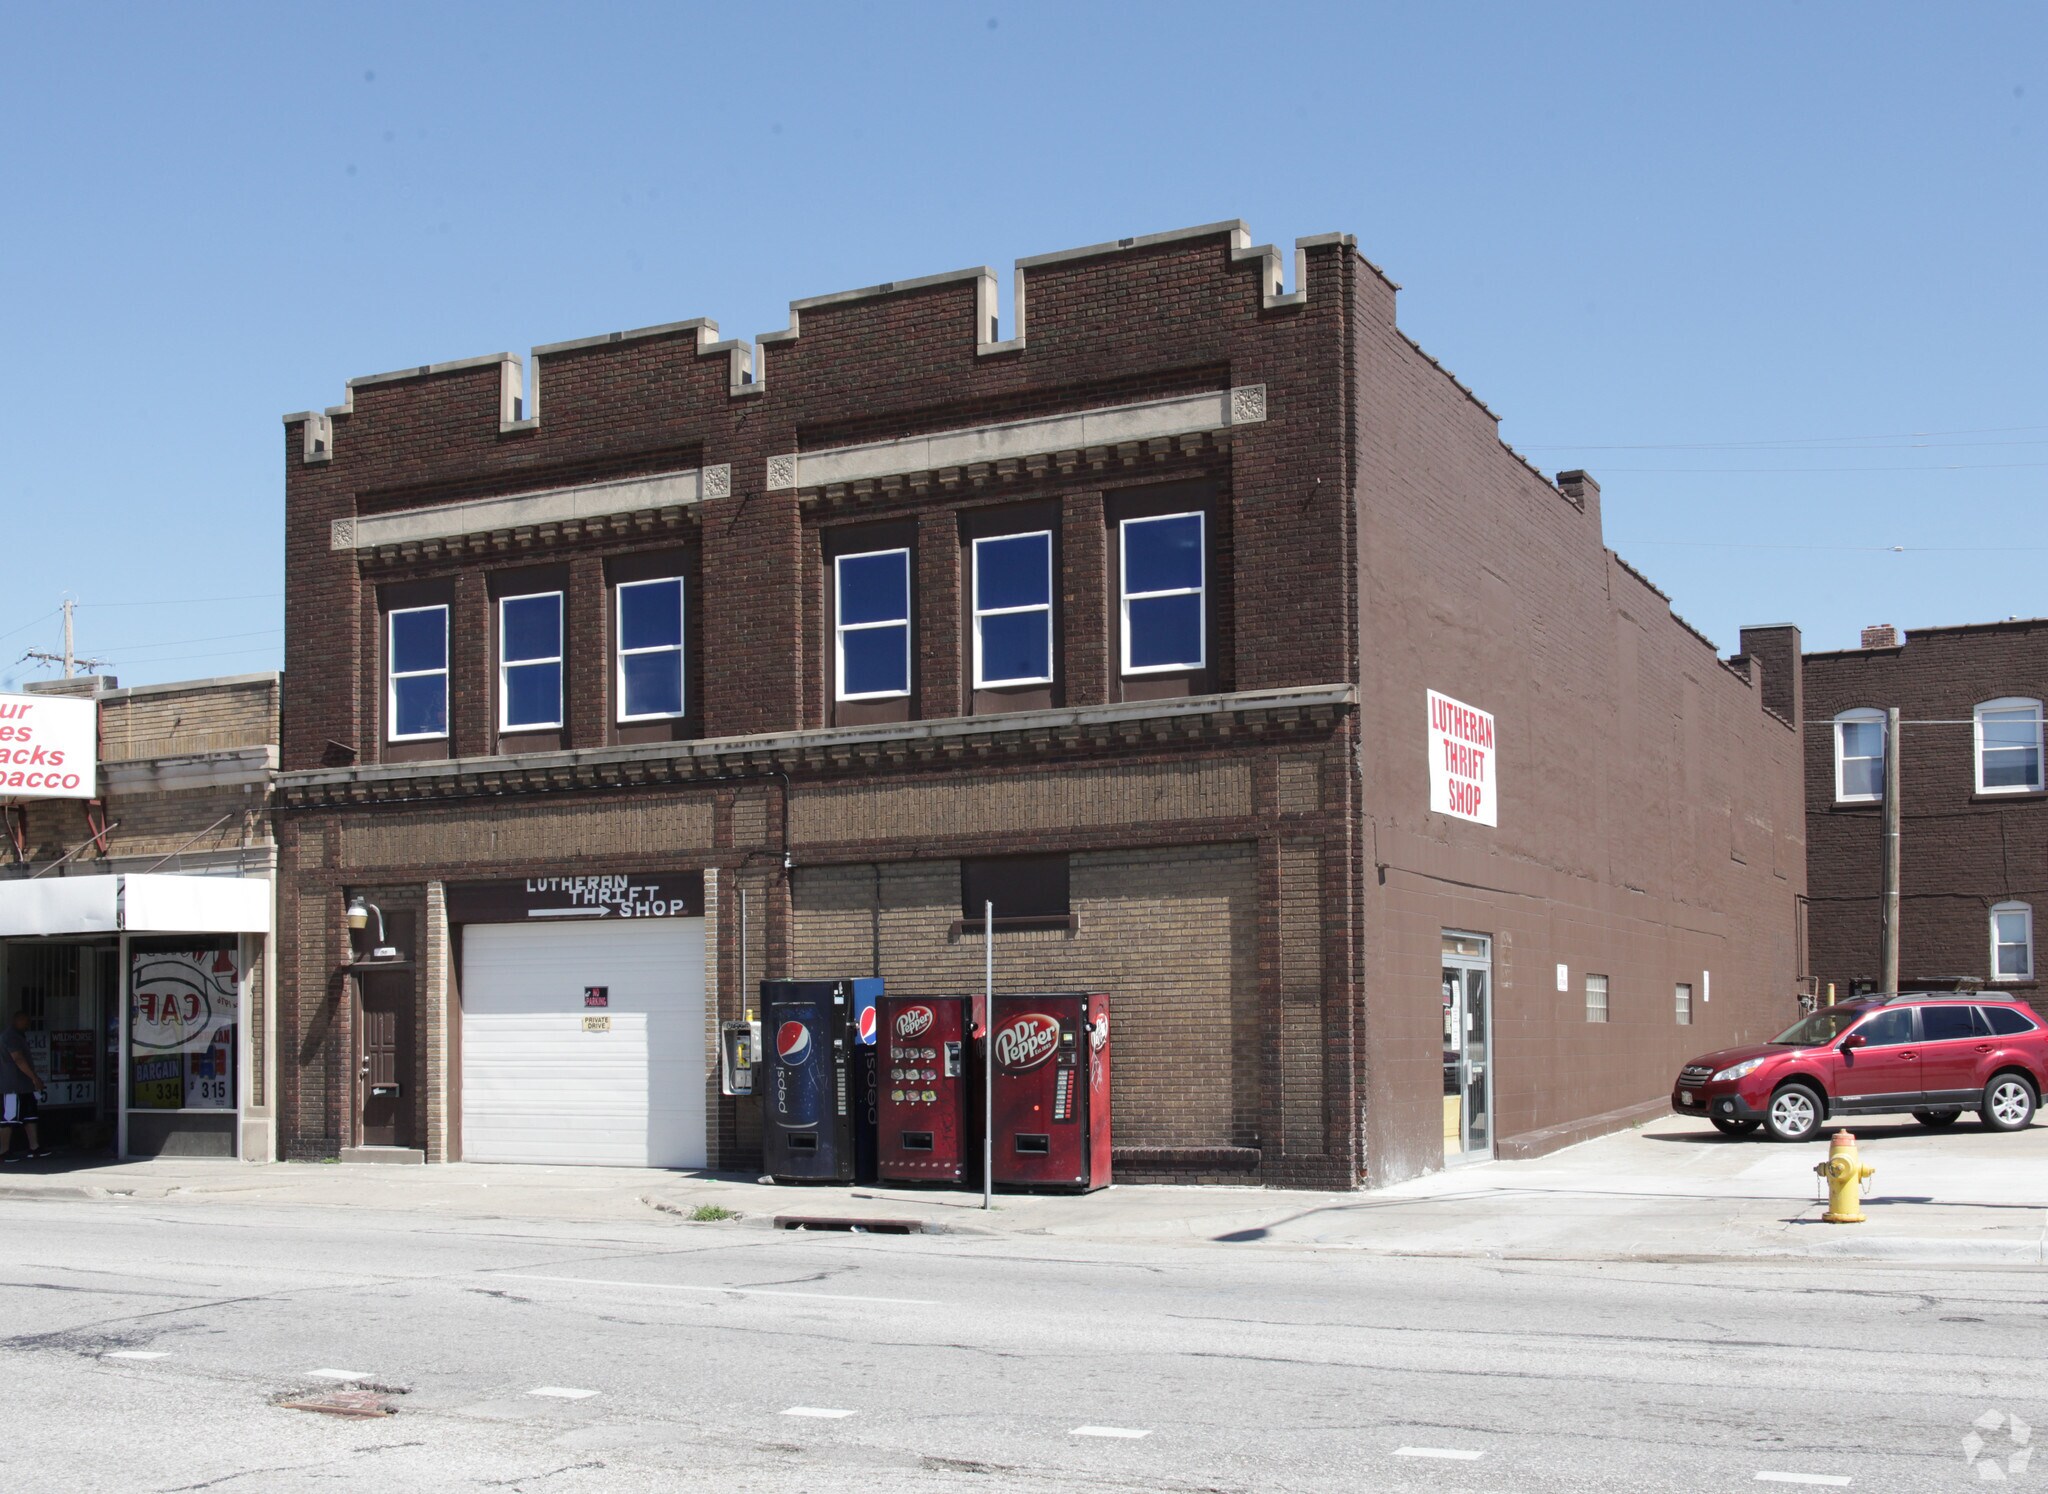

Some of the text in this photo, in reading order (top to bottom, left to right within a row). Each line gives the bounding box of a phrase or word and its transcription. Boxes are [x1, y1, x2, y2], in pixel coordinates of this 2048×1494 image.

[1431, 696, 1493, 749] LUTHERAN
[1443, 738, 1485, 782] THRIFT
[1448, 778, 1481, 816] SHOP
[526, 875, 628, 892] LUTHERAN
[568, 886, 659, 904] THRIFT
[619, 900, 683, 917] SHOP
[585, 997, 607, 1006] PARKING
[592, 988, 600, 997] NO
[898, 1013, 929, 1036] Pepper
[907, 1009, 920, 1020] Dr
[1014, 1021, 1038, 1044] Dr
[998, 1025, 1056, 1066] Pepper
[136, 1060, 179, 1082] BARGAIN
[776, 1066, 789, 1113] pepsi
[864, 1052, 877, 1125] pepsi
